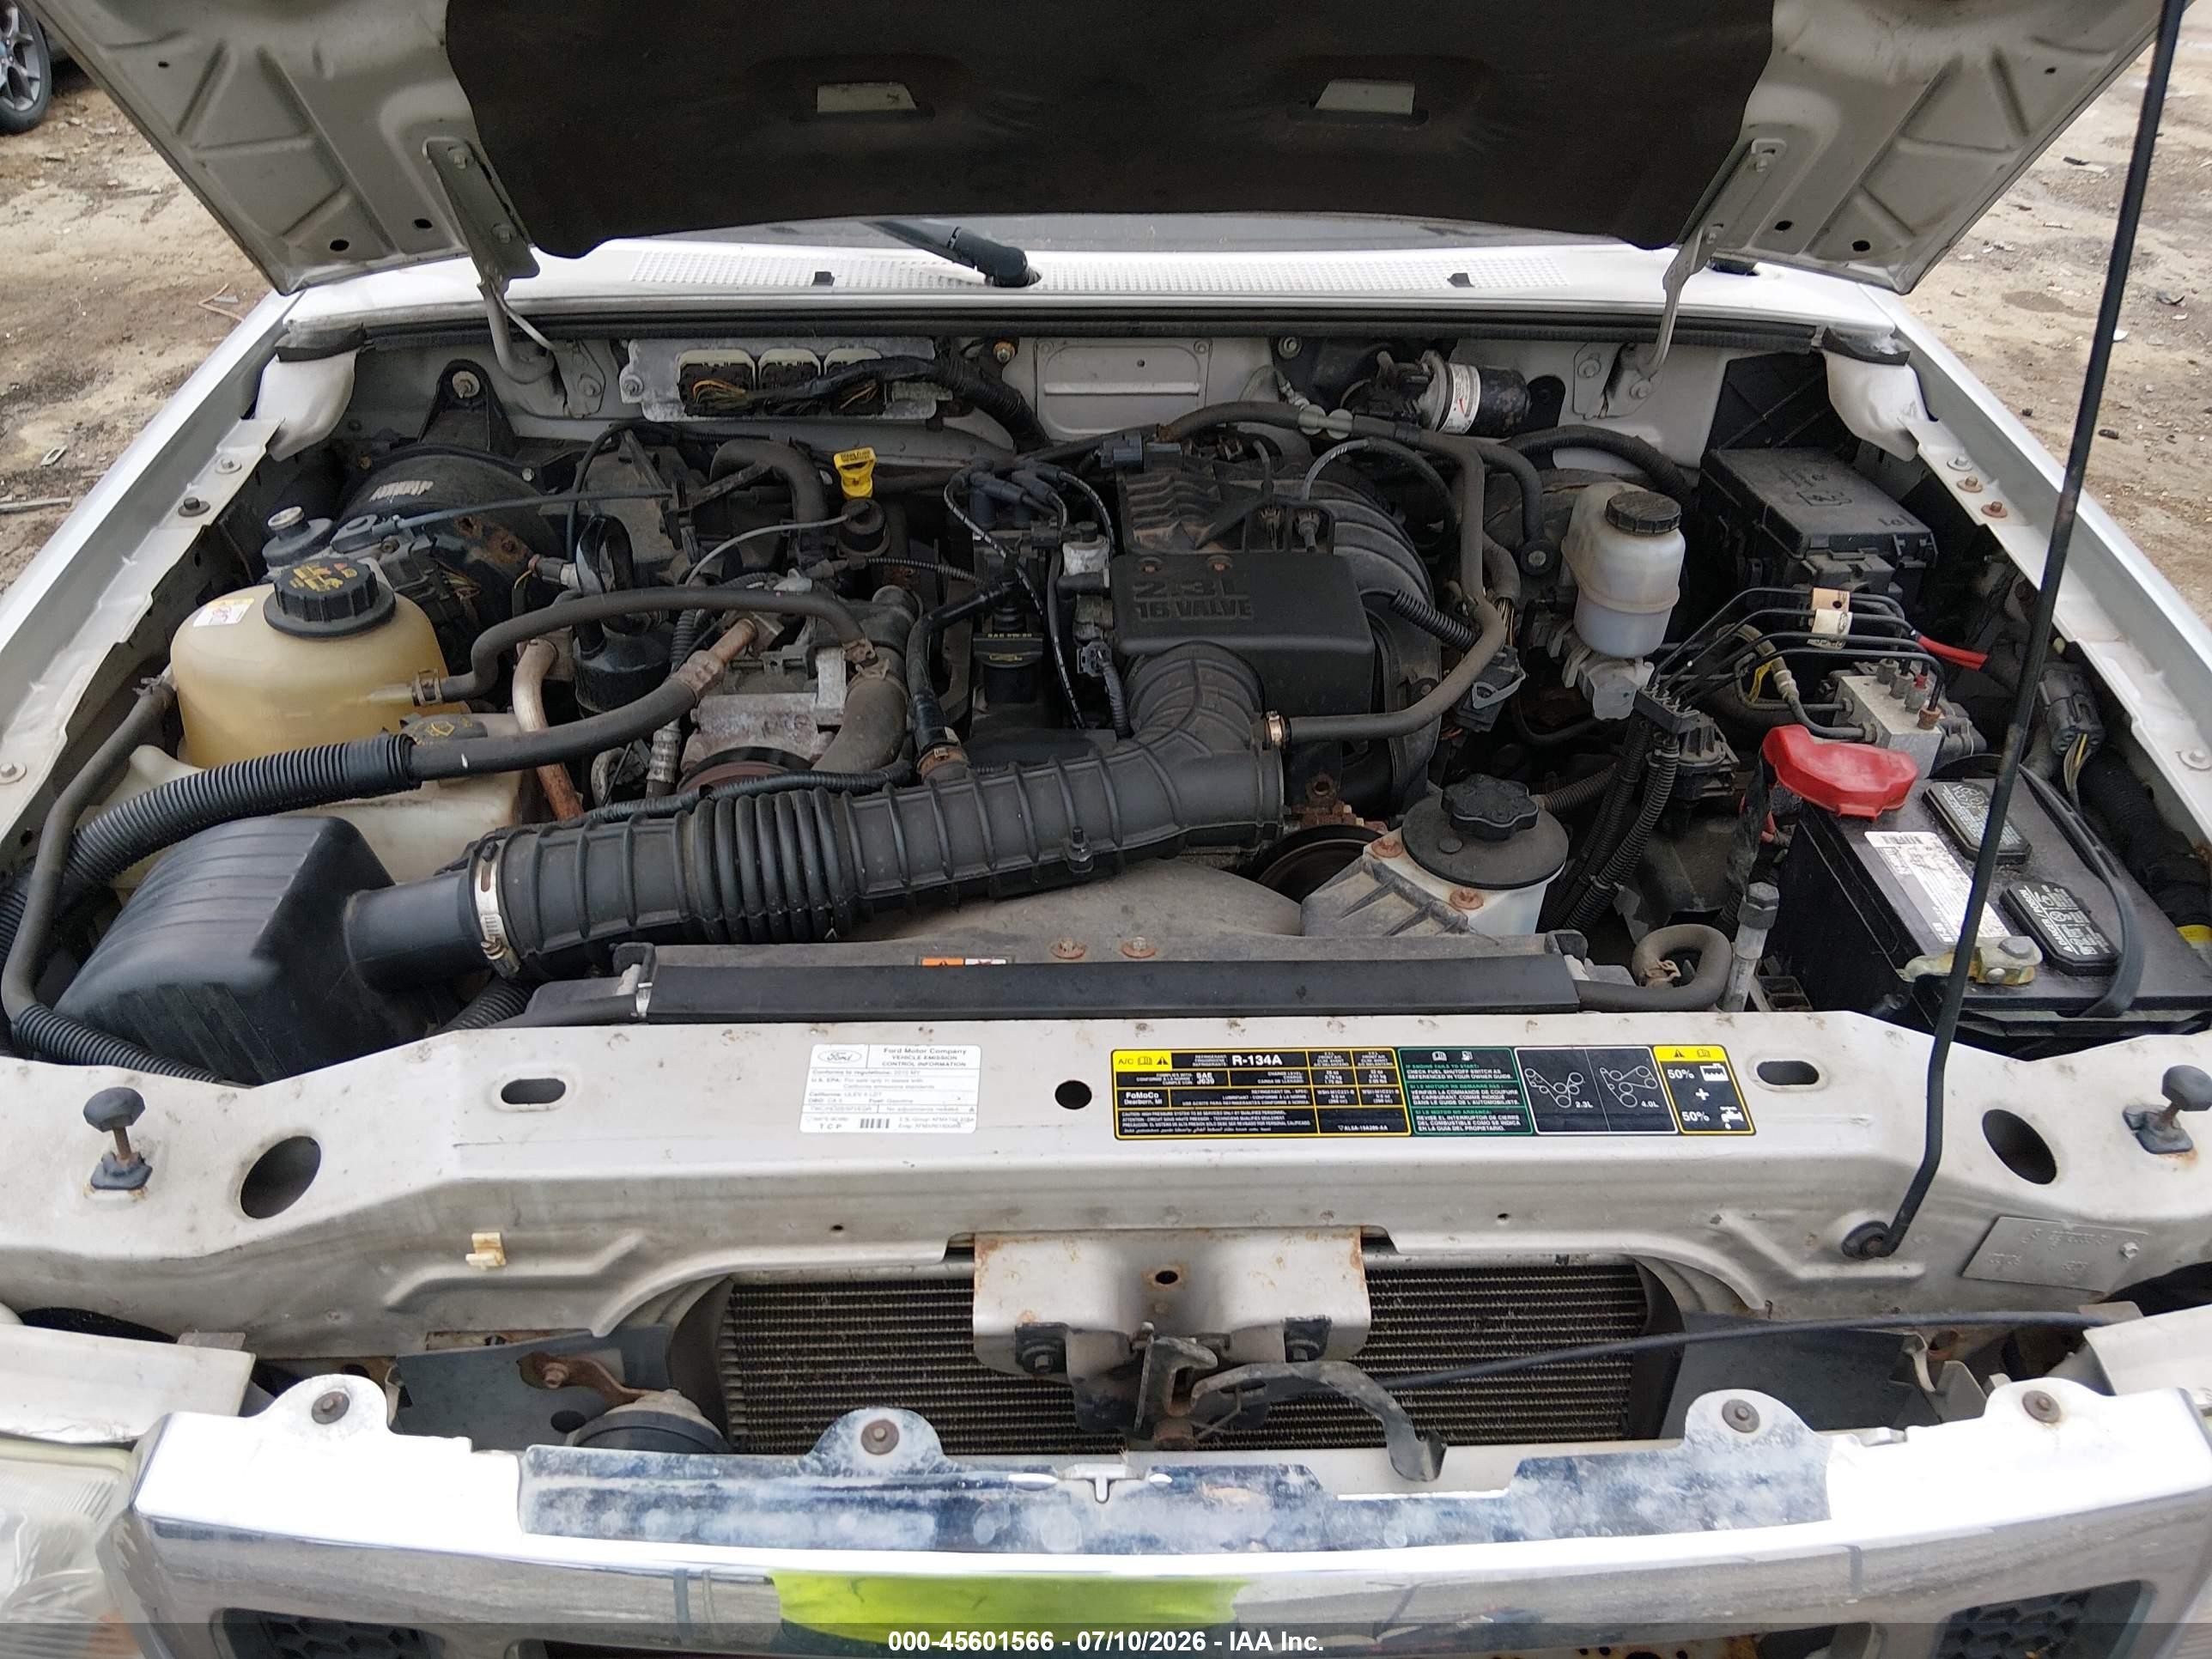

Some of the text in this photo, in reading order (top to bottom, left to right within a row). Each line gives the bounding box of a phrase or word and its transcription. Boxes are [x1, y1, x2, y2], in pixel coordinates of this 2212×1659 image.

[1231, 1054, 1283, 1066] R-134A
[1668, 1069, 1694, 1079] 50%
[1681, 1111, 1710, 1122] 50%
